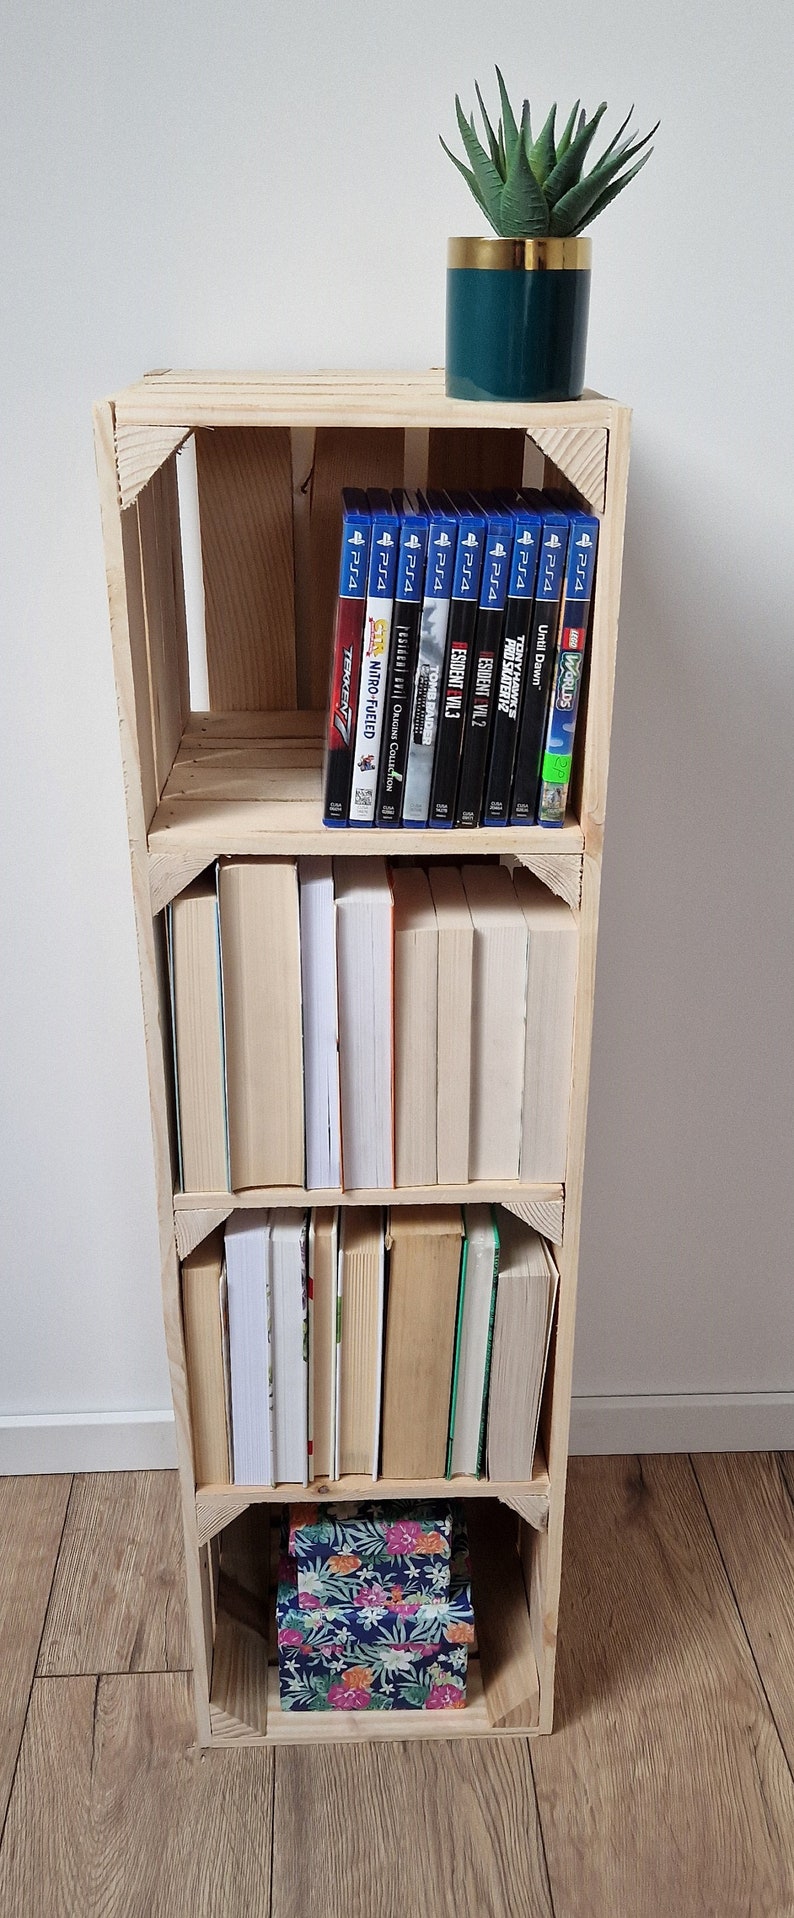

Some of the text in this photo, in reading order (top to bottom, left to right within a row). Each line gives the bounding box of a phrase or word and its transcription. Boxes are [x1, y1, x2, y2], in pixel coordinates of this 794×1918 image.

[349, 551, 361, 591] PS4
[377, 552, 389, 591] PS4
[404, 555, 416, 593] PS4
[433, 553, 446, 592] PS4
[461, 553, 474, 592] PS4
[488, 563, 501, 601] PS4
[517, 551, 529, 589] PS4
[543, 554, 556, 592] PS4
[575, 554, 587, 592] PS4
[374, 618, 388, 657] CTR
[503, 638, 517, 661] PRO
[514, 635, 525, 671] TONY
[532, 624, 549, 686] Until Dawn
[569, 628, 579, 650] LEGO
[444, 641, 468, 719] RESIDENT EVIL 3
[475, 651, 495, 697] RESIDENT
[499, 660, 514, 699] SKATER
[333, 645, 353, 747] TEKKEN 7
[422, 665, 440, 746] TOMB RAIDER
[472, 698, 490, 719] EVIL
